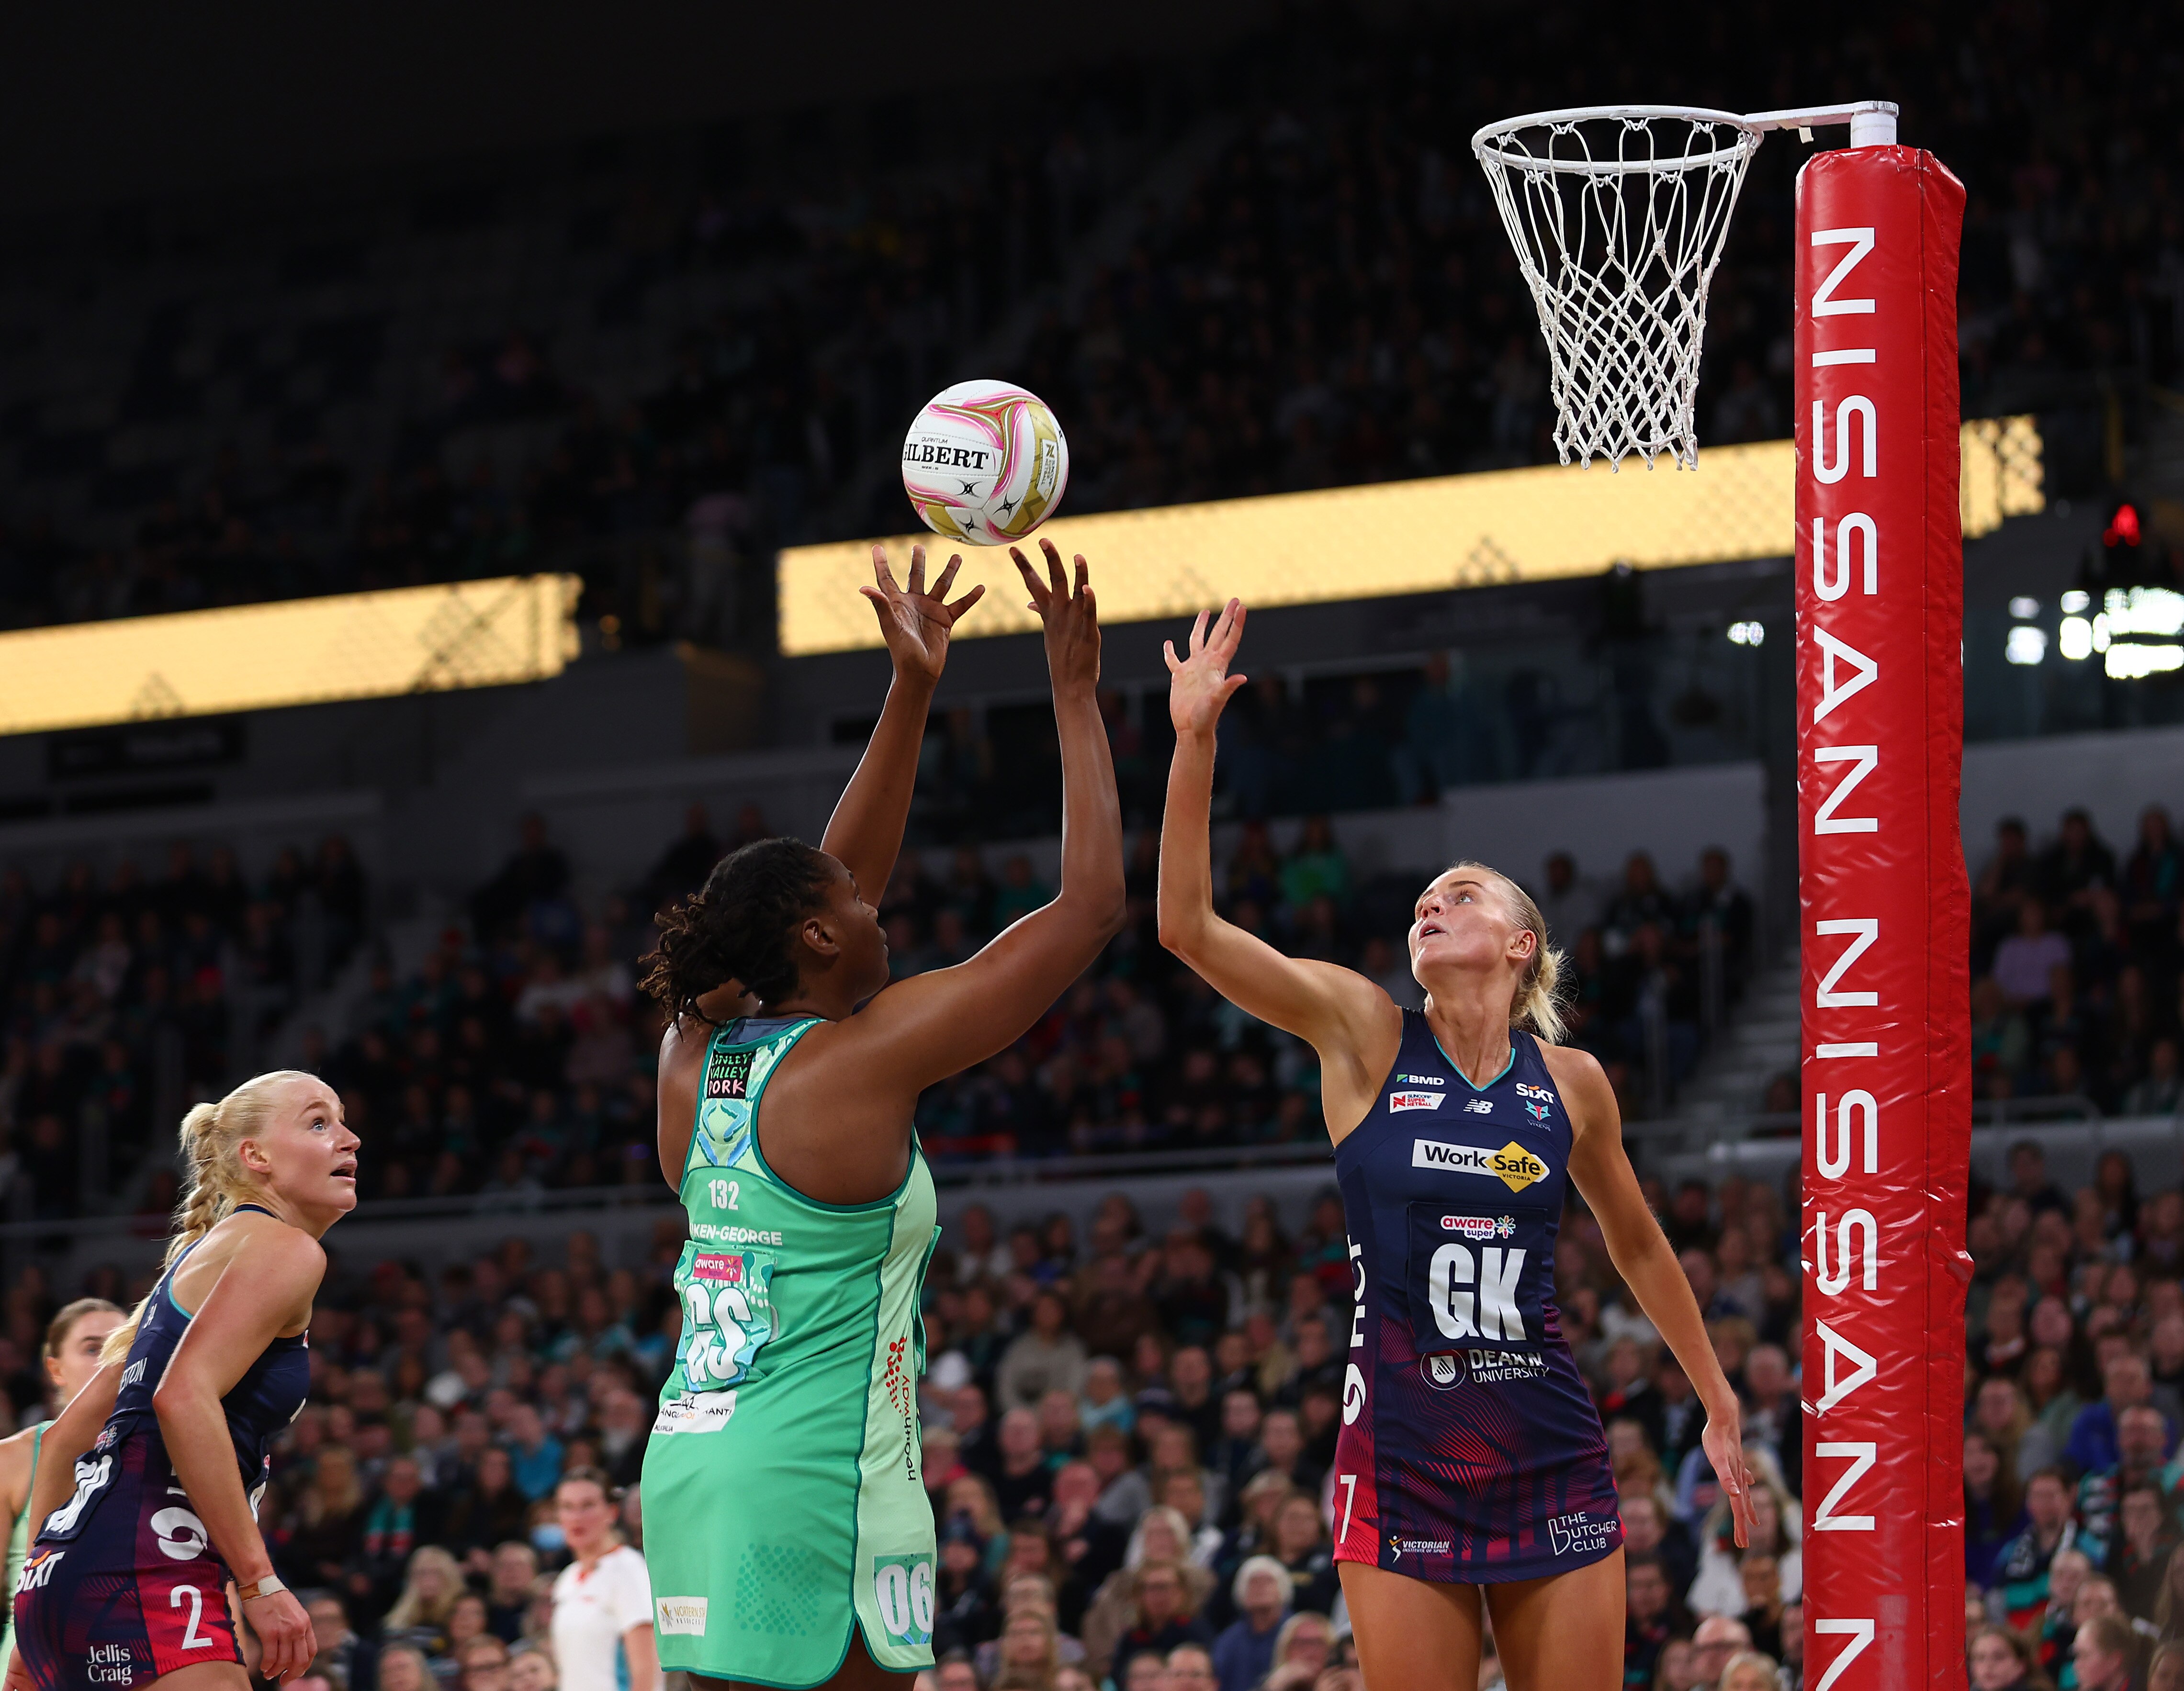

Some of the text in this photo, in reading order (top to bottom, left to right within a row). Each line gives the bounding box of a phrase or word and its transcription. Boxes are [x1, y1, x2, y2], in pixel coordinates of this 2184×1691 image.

[1812, 227, 1878, 835] NISSAN
[710, 1066, 748, 1079] VALLEY
[1409, 1075, 1444, 1086] BMD
[709, 1079, 745, 1096] PORK
[1424, 1145, 1541, 1176] Work Safe
[708, 1179, 739, 1210] 132
[1443, 1217, 1494, 1230] aware
[1466, 1229, 1493, 1238] super
[1814, 918, 1878, 1531] NISSAN
[695, 1258, 725, 1270] aware
[1429, 1243, 1528, 1341] GK
[686, 1283, 753, 1382] GS
[1473, 1366, 1550, 1383] UNIVERSITY
[1339, 1474, 1357, 1544] 7
[1558, 1511, 1588, 1527] THE
[1573, 1537, 1607, 1553] CLUB
[875, 1561, 934, 1636] 06
[170, 1584, 214, 1650] 2
[87, 1644, 131, 1663] Jellis
[88, 1663, 133, 1686] Craig
